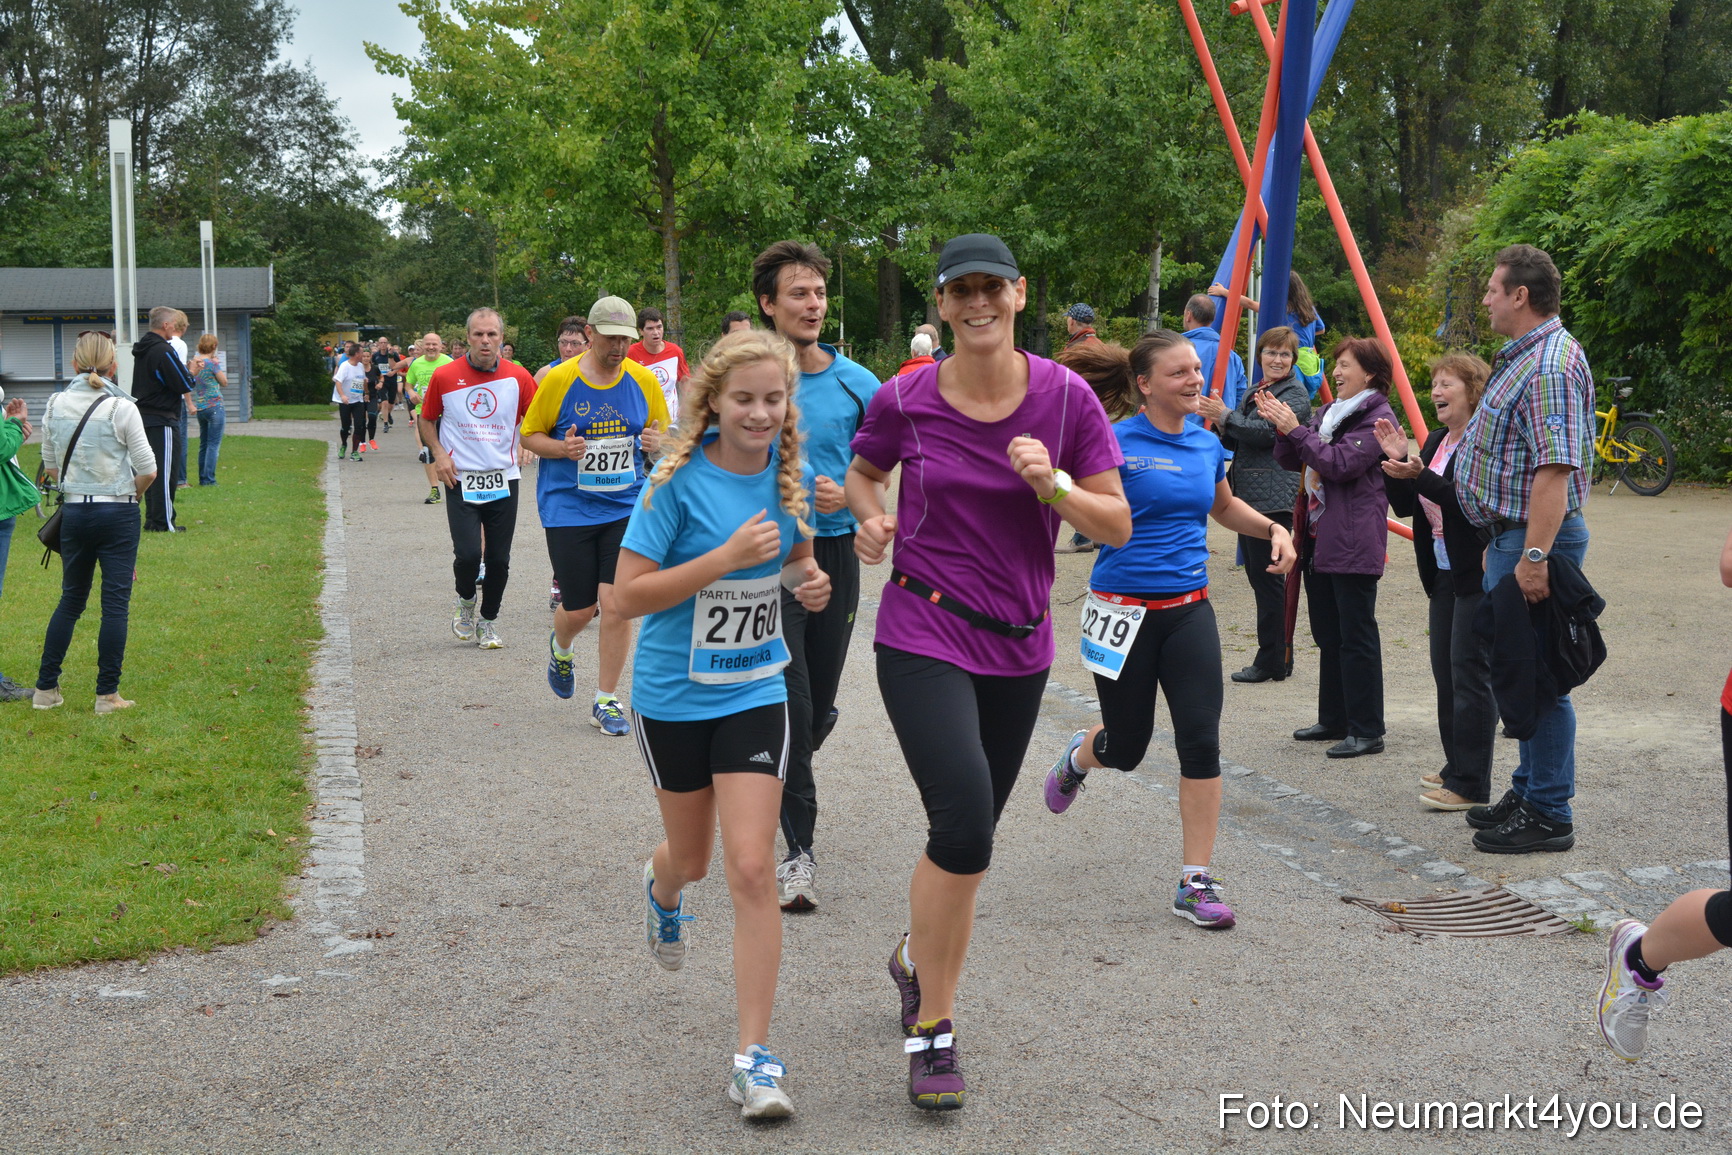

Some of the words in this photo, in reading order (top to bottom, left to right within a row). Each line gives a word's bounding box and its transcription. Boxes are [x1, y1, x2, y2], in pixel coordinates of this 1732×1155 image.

[585, 450, 629, 471] 2872
[466, 473, 504, 491] 2939
[595, 476, 620, 484] Robert
[700, 590, 738, 600] PARTL
[740, 586, 777, 600] Neumarkt
[705, 598, 778, 644] 2760
[1082, 607, 1130, 648] 2219
[711, 649, 772, 669] Fredericka
